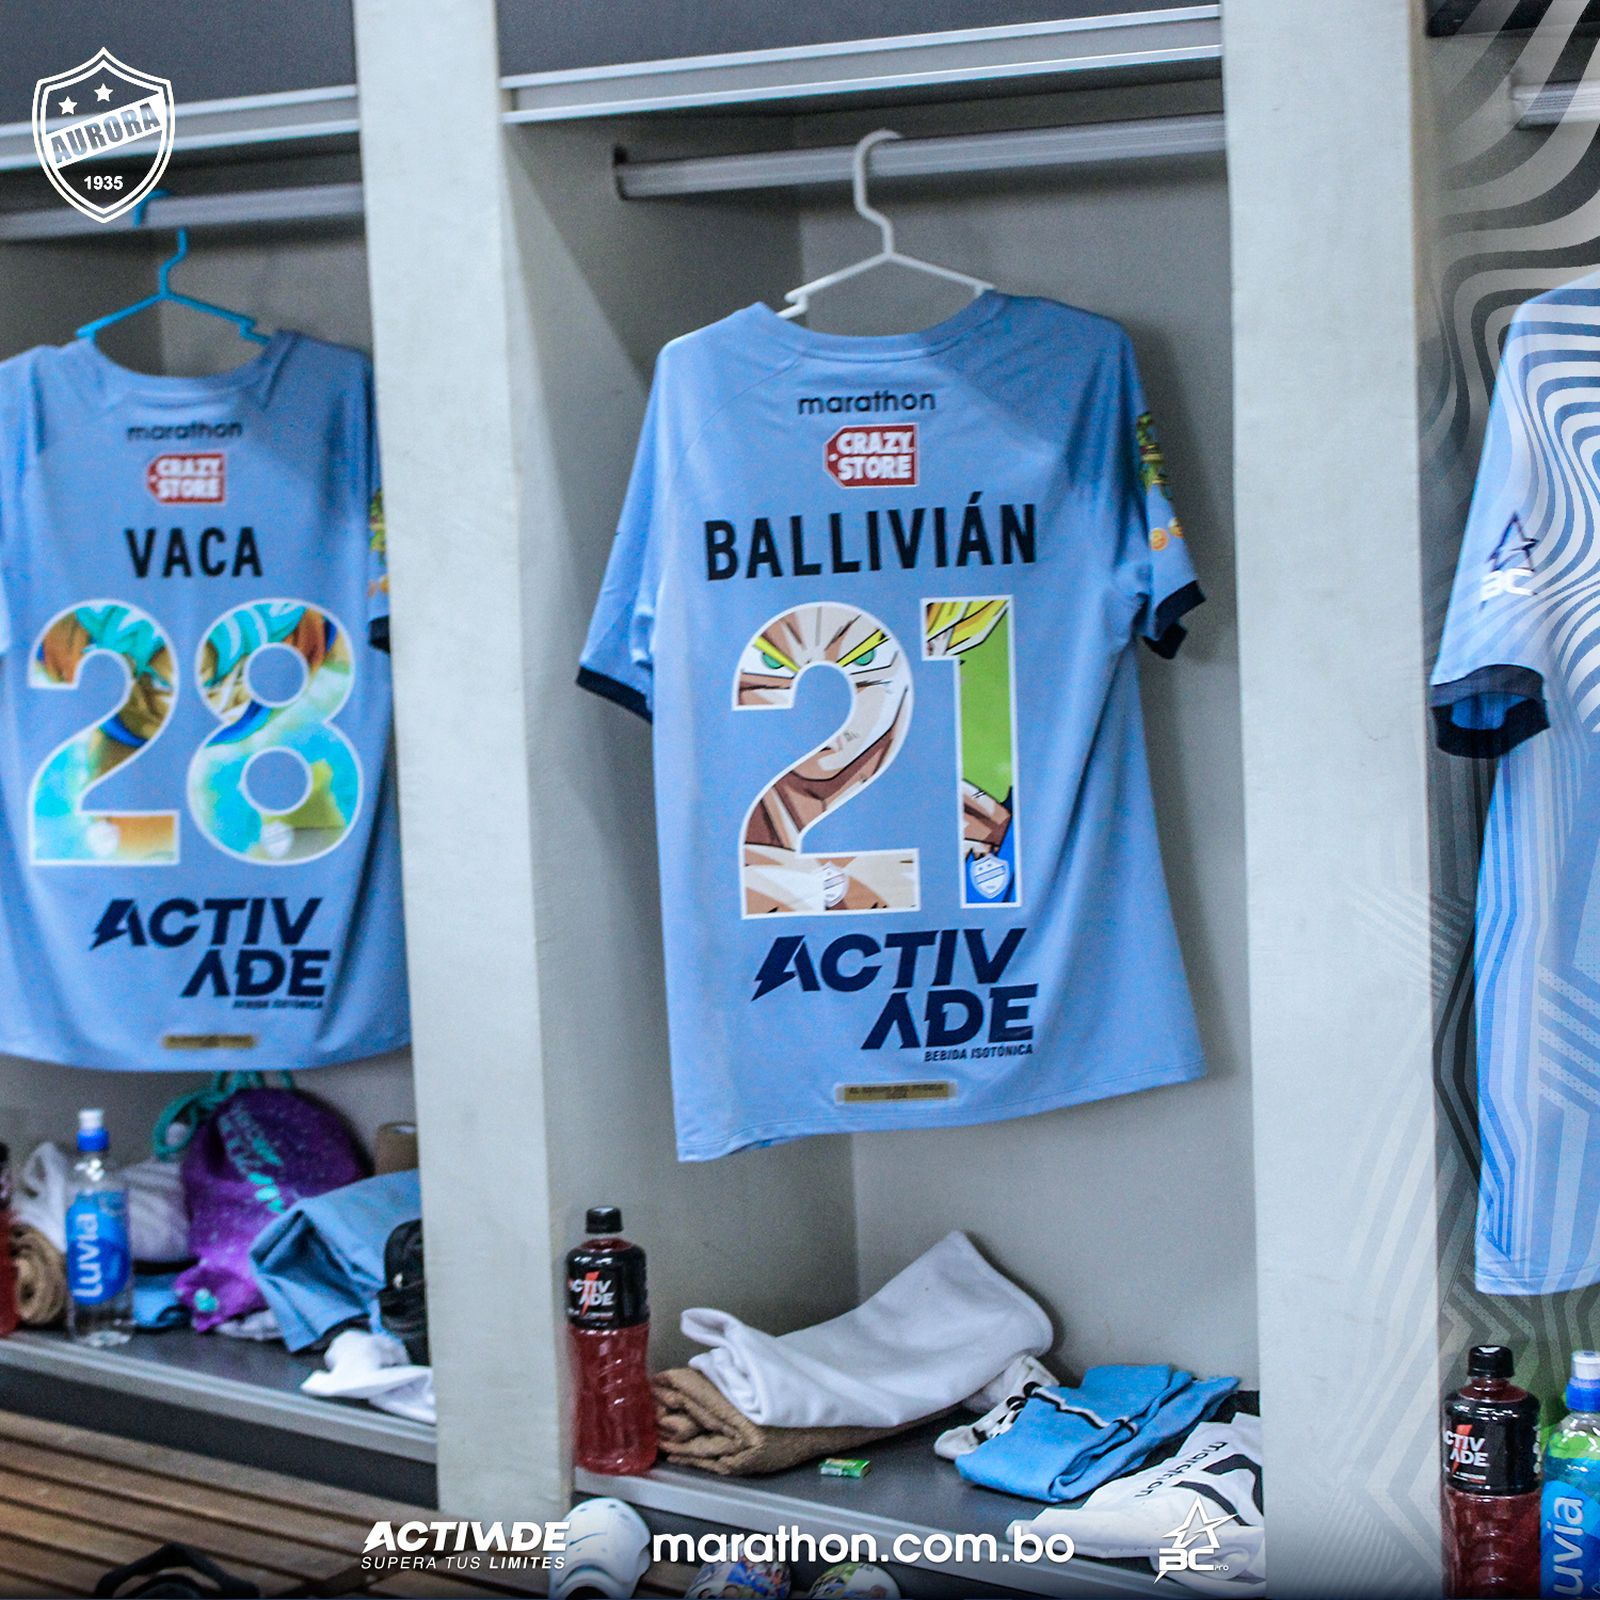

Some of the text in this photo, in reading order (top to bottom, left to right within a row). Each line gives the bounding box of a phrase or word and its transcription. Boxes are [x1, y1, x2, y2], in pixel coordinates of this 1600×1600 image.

[797, 390, 936, 415] marathon
[127, 420, 243, 440] marathon
[836, 431, 915, 455] CRAZY
[837, 455, 912, 480] STORE
[124, 526, 263, 578] VACA
[704, 491, 1036, 581] BALLIVIÁN
[28, 597, 364, 866] 28
[731, 594, 1022, 920] 21
[89, 897, 325, 950] ACTIV
[180, 949, 332, 998] ADE
[751, 928, 1027, 1001] ACTIV
[860, 983, 1039, 1050] ADE
[924, 1048, 967, 1062] BEBIDA
[567, 1278, 612, 1294] CTIV
[1450, 1448, 1490, 1467] ADE
[1547, 1497, 1584, 1600] uvia
